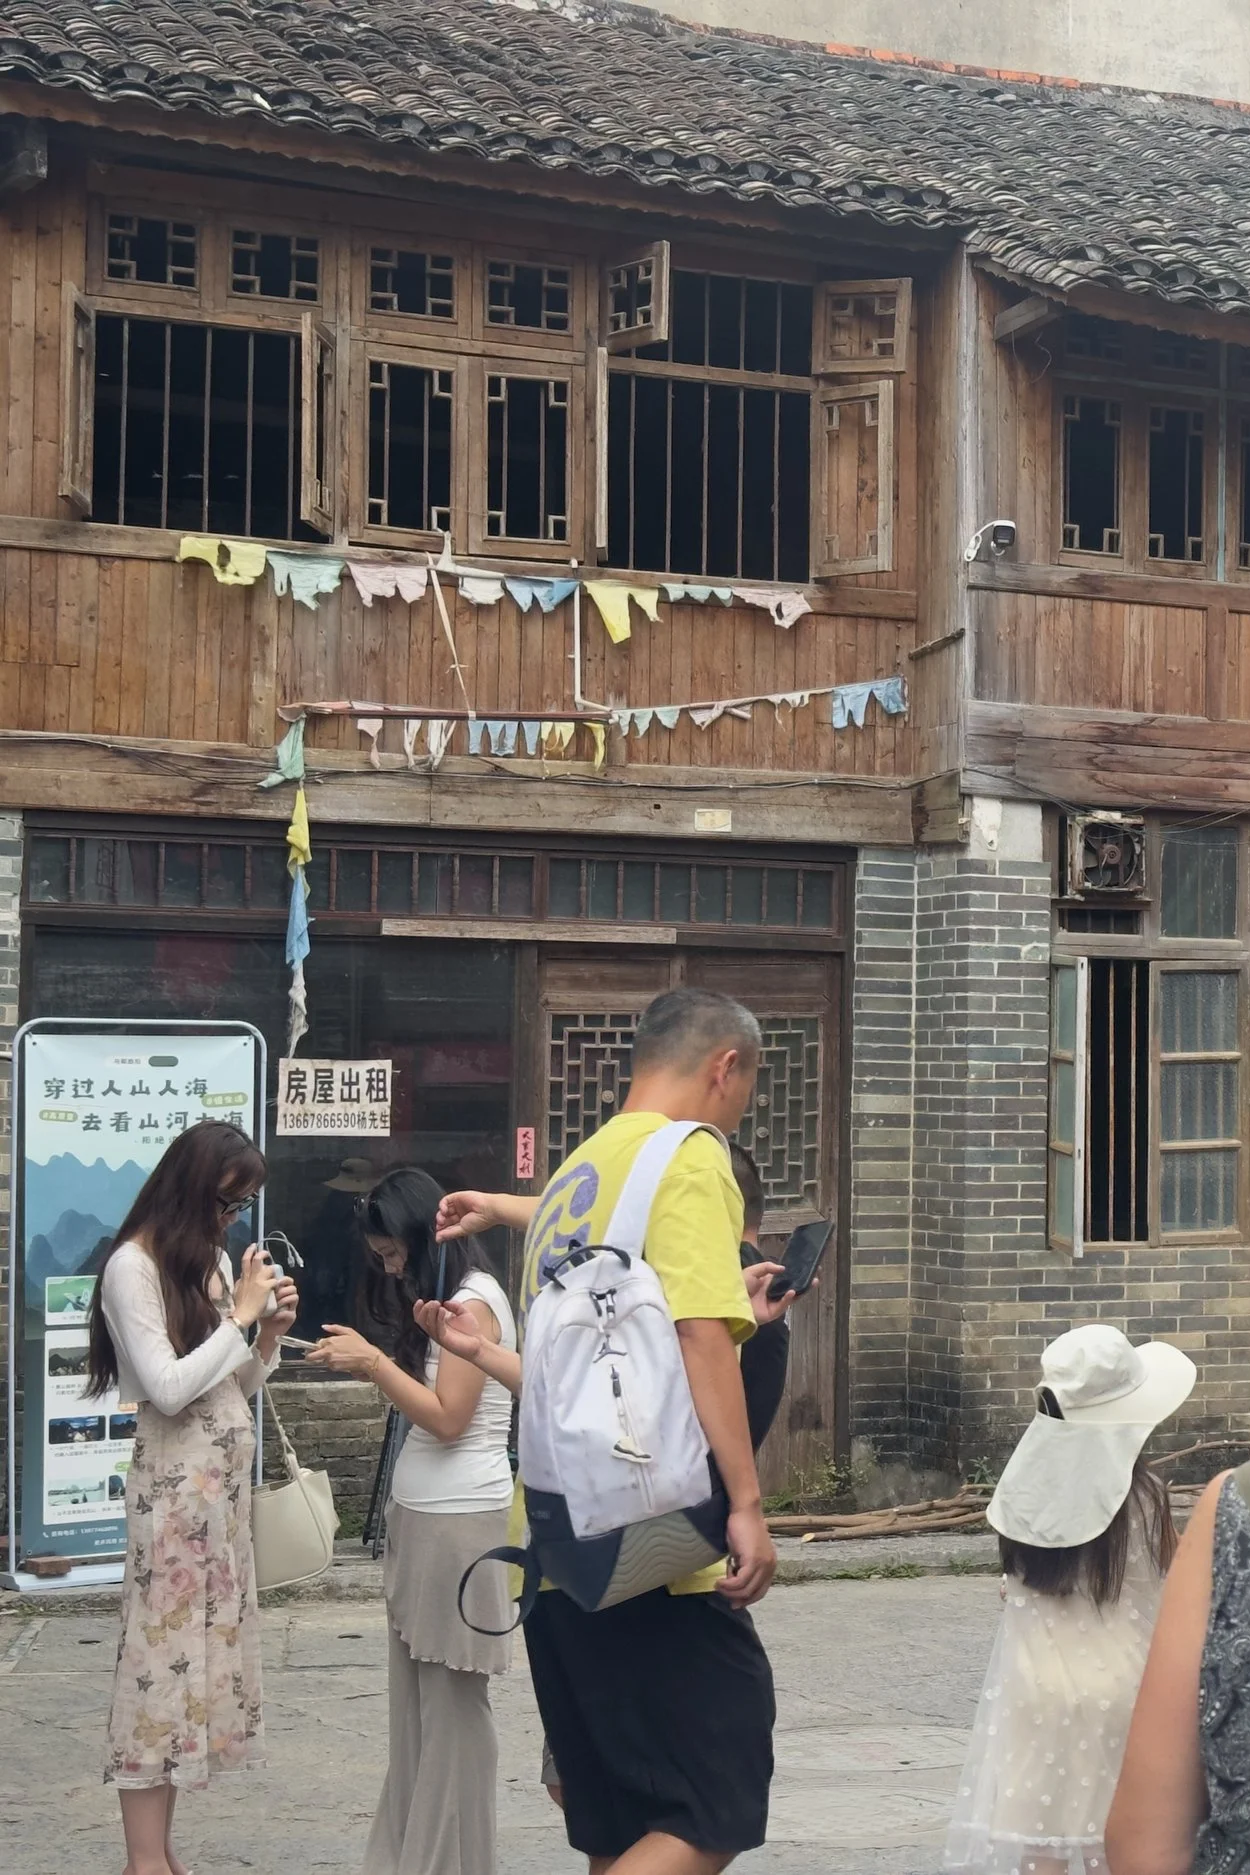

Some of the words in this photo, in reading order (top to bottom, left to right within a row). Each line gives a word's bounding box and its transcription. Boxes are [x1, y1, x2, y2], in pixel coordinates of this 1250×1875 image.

[43, 1077, 209, 1099] 穿过人山人海
[285, 1067, 388, 1104] 房屋出租
[282, 1110, 390, 1130] 13667866590杨先生
